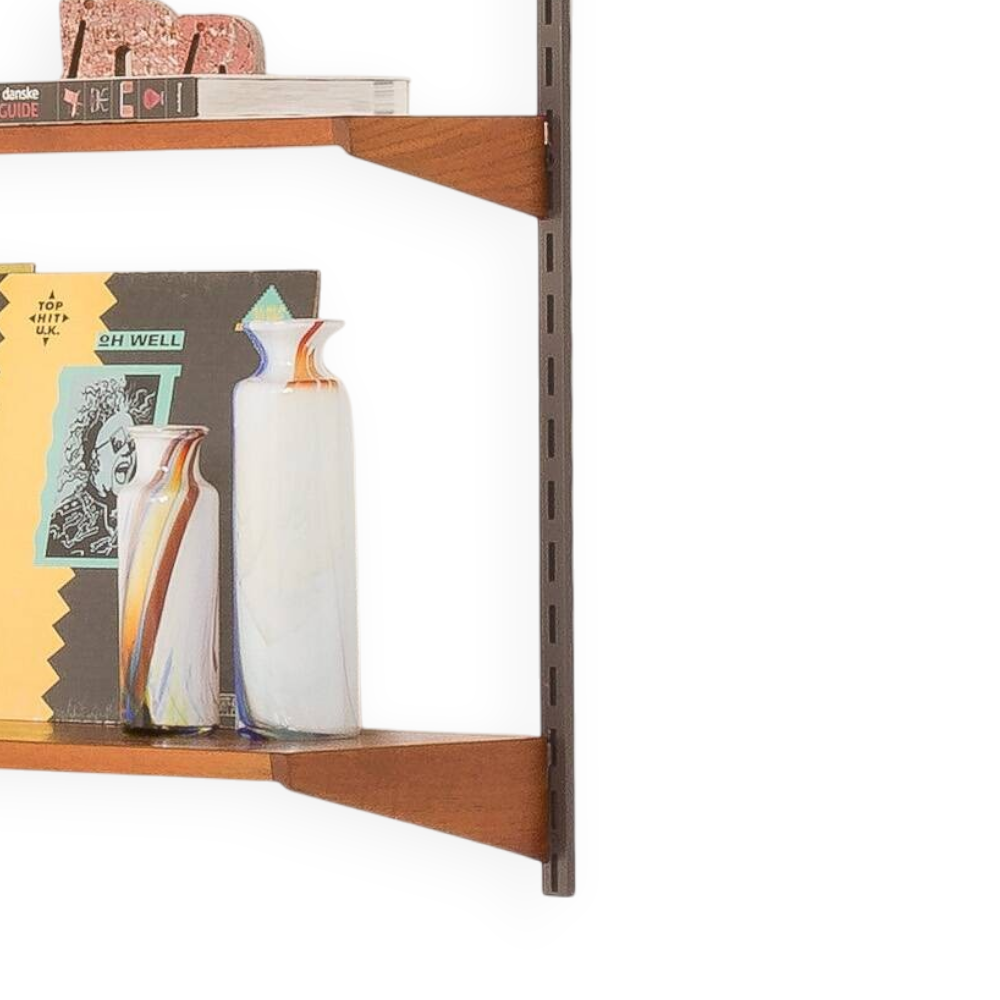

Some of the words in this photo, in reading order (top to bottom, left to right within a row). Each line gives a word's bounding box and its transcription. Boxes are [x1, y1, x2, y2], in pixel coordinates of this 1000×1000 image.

[2, 86, 40, 100] danske
[38, 301, 63, 311] TOP
[37, 313, 60, 323] HIT
[35, 325, 60, 335] U.K.
[130, 333, 181, 347] WELL
